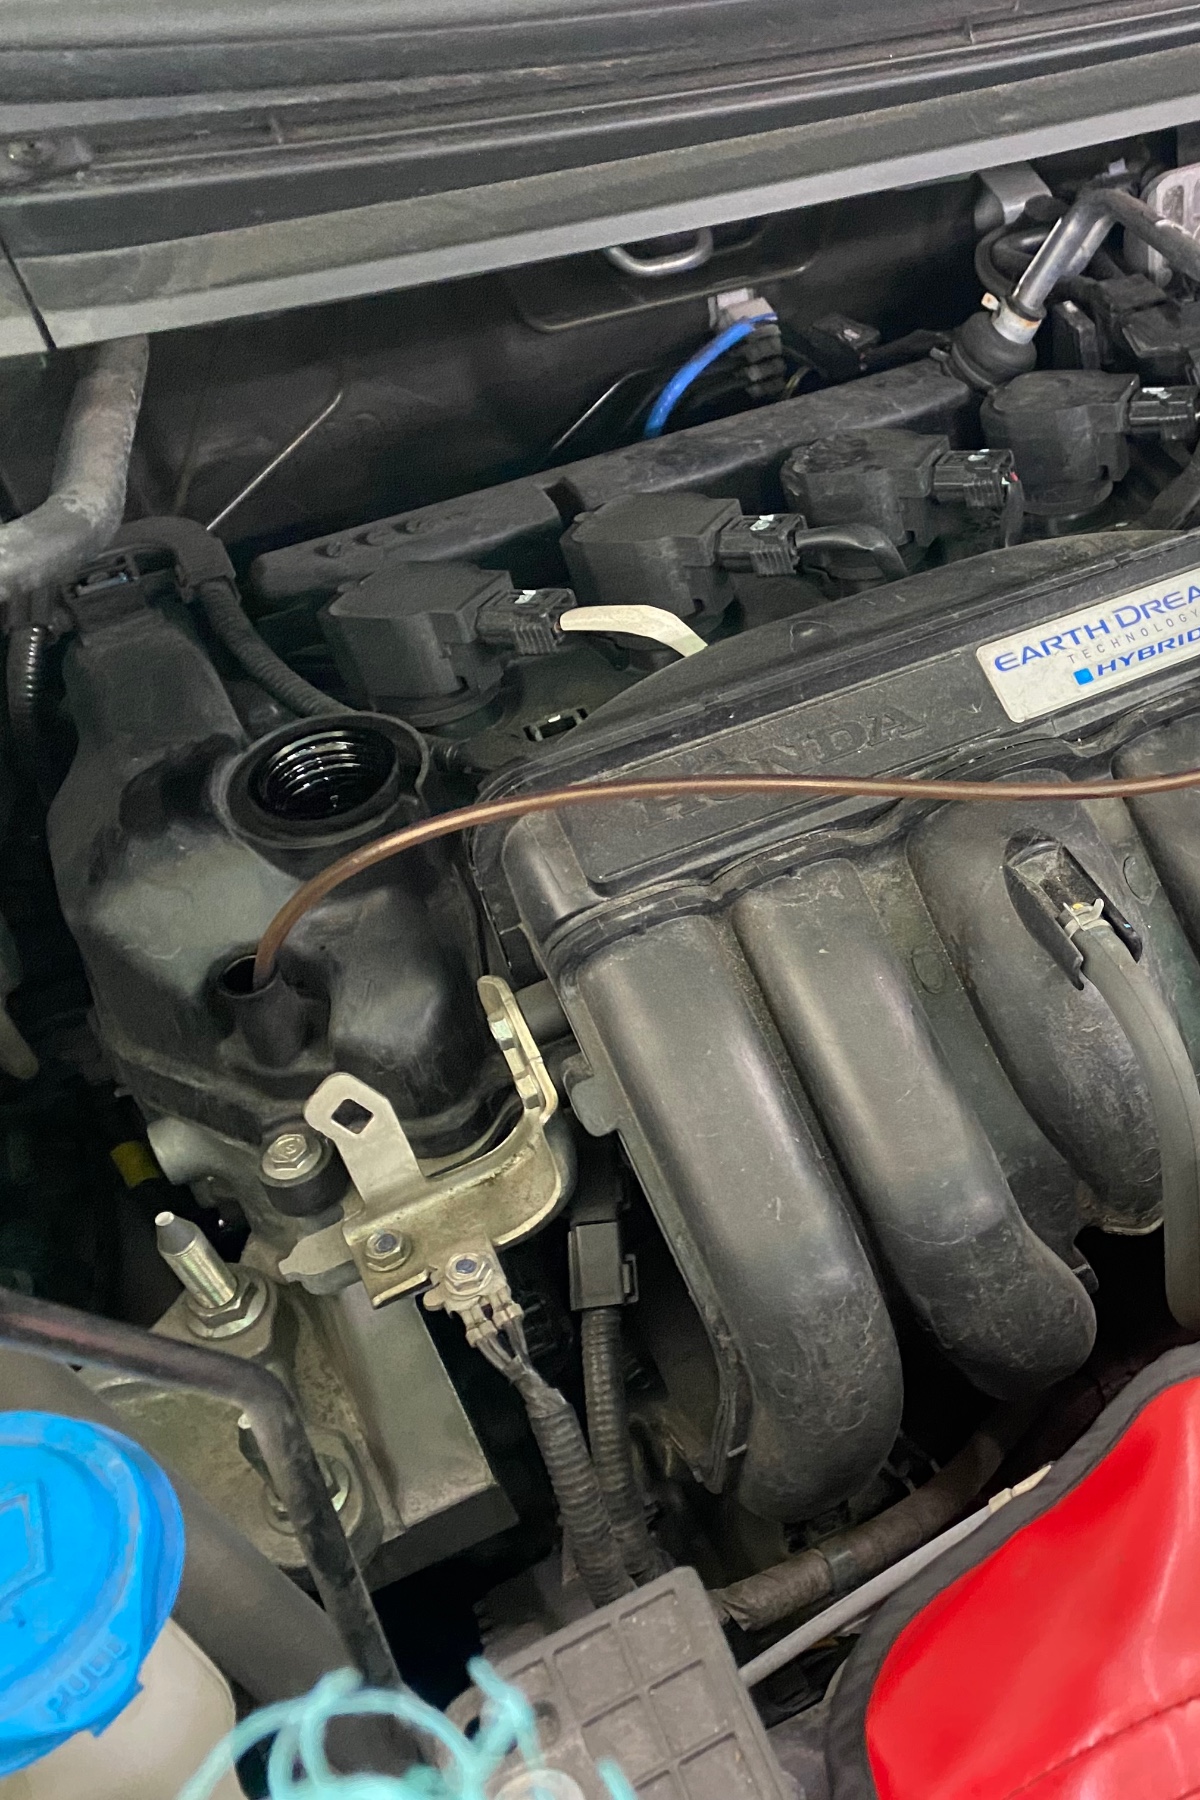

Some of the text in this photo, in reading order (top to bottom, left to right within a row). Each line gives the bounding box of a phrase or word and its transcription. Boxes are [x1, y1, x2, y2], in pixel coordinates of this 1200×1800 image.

[994, 618, 1111, 672] EARTH
[1067, 608, 1200, 665] TECHNOLOGY
[45, 1641, 132, 1723] PULL
